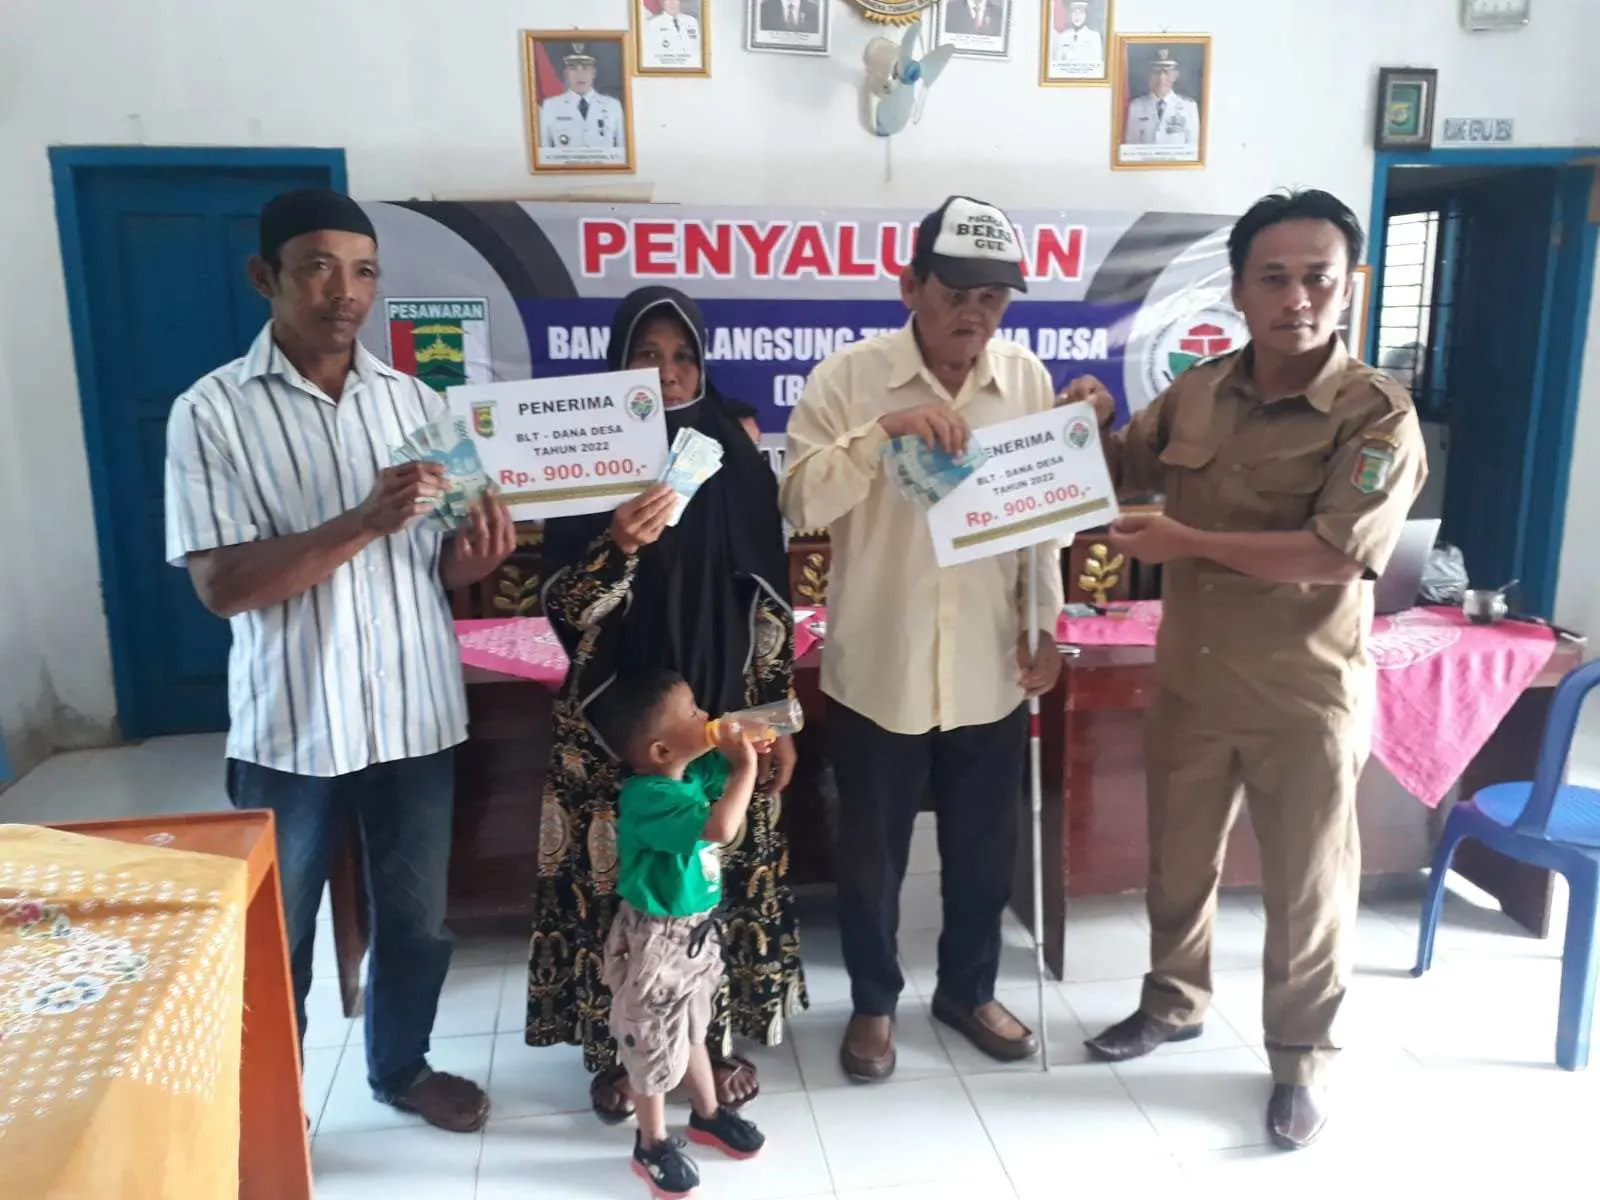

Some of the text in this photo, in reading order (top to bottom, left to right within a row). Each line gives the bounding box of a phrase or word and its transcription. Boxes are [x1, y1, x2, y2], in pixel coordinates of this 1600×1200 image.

[582, 220, 1084, 279] PENYALUN
[390, 303, 483, 319] PESAWARAN
[1037, 326, 1109, 361] DESA
[518, 395, 615, 416] PENERIMA
[516, 431, 540, 443] BLT
[552, 427, 588, 440] DANA
[591, 424, 623, 435] DESA
[533, 442, 611, 457] TAHUN 2022
[983, 430, 1055, 459] ENERIMA
[499, 468, 537, 487] Rp.
[1004, 463, 1034, 479] DANA
[1036, 455, 1065, 470] DESA
[992, 472, 1055, 496] TAHUN 2022
[965, 511, 999, 528] Rp.
